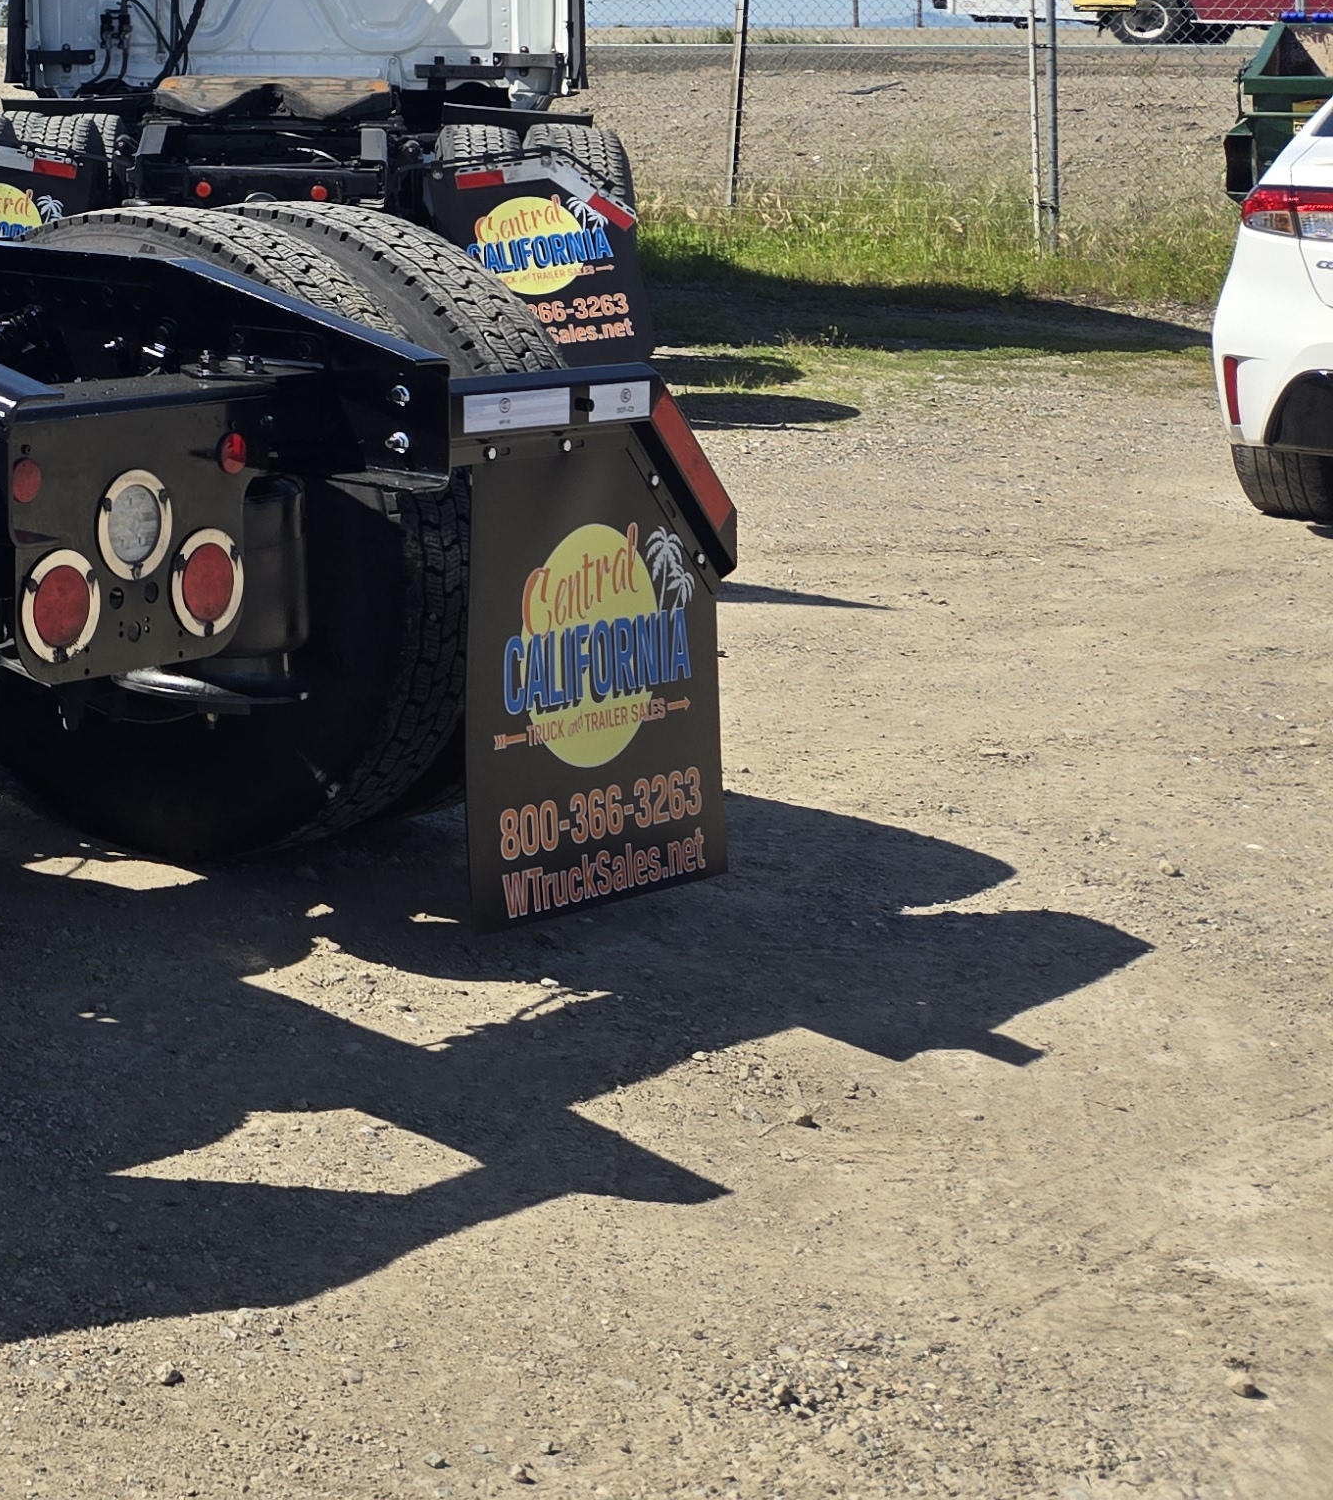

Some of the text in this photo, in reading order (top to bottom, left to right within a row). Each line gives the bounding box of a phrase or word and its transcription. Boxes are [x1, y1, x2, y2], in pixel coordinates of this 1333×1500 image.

[475, 193, 565, 244] Central
[532, 269, 566, 282] TRAILER
[567, 265, 595, 277] SALES
[546, 318, 634, 344] Sales.net
[522, 522, 639, 639] Central
[503, 607, 692, 716] CALIFORNIA
[526, 697, 667, 747] TRUCK and TRAILER SALES
[500, 767, 702, 860] 800-366-3263
[502, 828, 707, 919] WTruckSales.net
